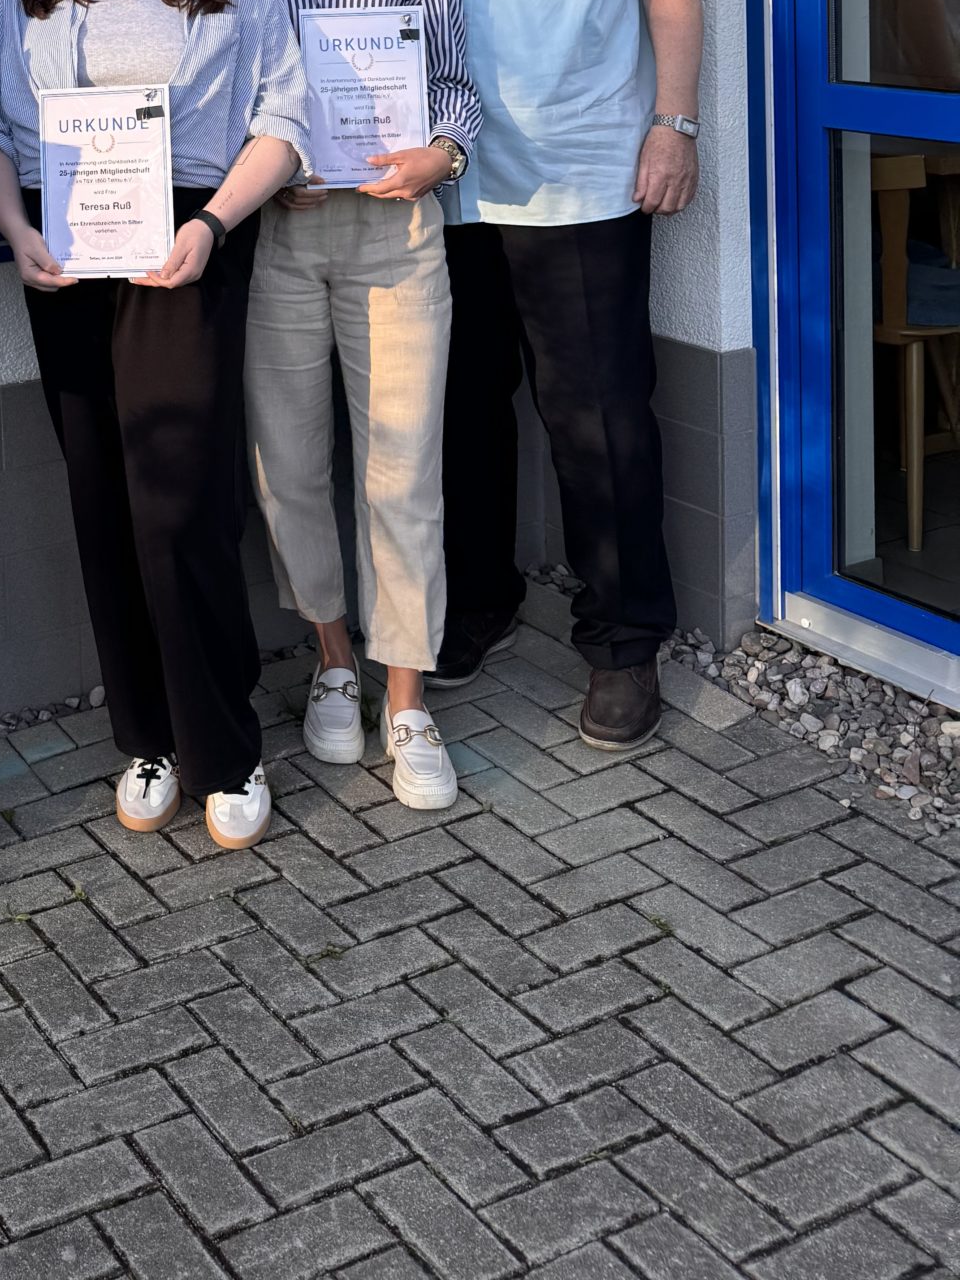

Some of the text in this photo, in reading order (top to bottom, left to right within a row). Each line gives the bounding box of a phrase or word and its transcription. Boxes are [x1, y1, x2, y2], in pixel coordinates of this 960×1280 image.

[319, 36, 406, 52] URKUNDE
[320, 83, 407, 94] 25-jährigen Mitgliedschaft
[59, 116, 150, 133] URKUNDE
[340, 115, 391, 126] Miriam Ruß
[59, 167, 150, 178] 25-jährigen Mitgliedschaft
[79, 201, 132, 211] Teresa Ruß
